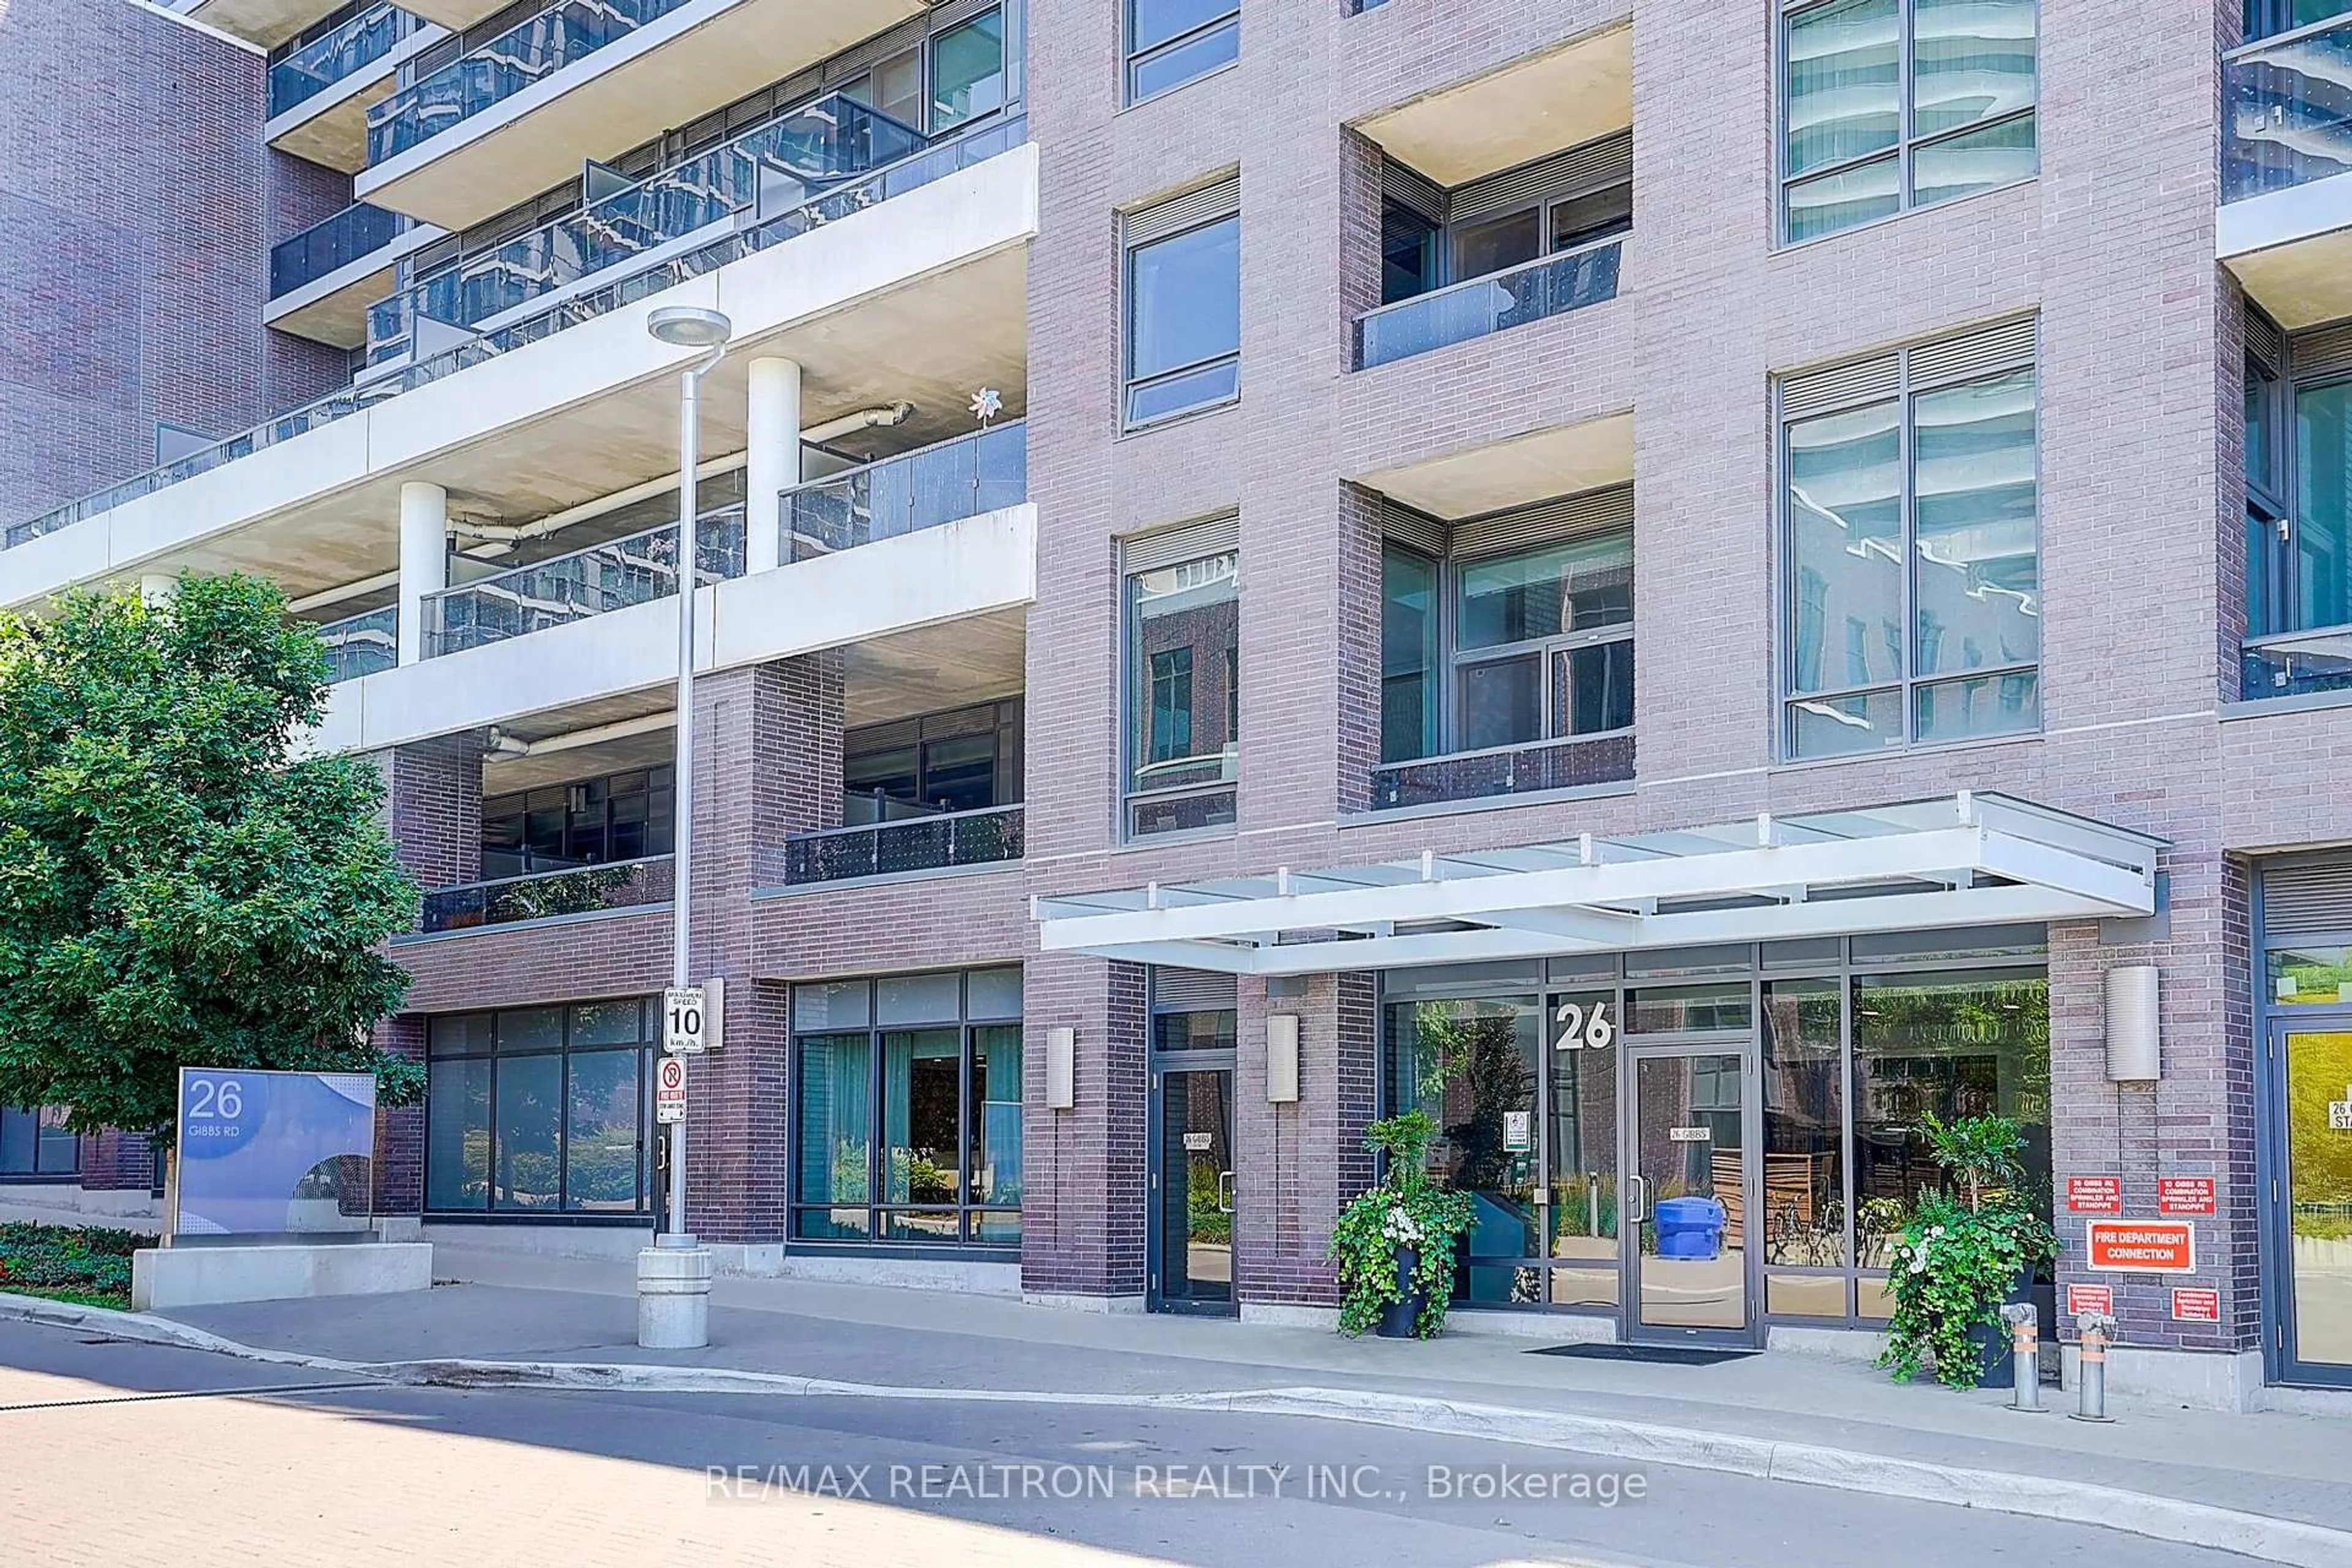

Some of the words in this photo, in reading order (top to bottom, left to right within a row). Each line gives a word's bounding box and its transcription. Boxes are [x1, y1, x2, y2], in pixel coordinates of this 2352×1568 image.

[669, 1008, 700, 1035] 10
[1556, 1001, 1611, 1049] 26
[189, 1079, 242, 1119] 26
[2333, 1102, 2345, 1114] 26
[189, 1126, 221, 1137] GIBBS
[224, 1126, 240, 1137] RD
[1683, 1129, 1706, 1139] GIBBS
[2095, 1231, 2117, 1243] FIRE
[2119, 1232, 2186, 1245] DEPARTMENT
[2107, 1248, 2174, 1261] CONNECTION
